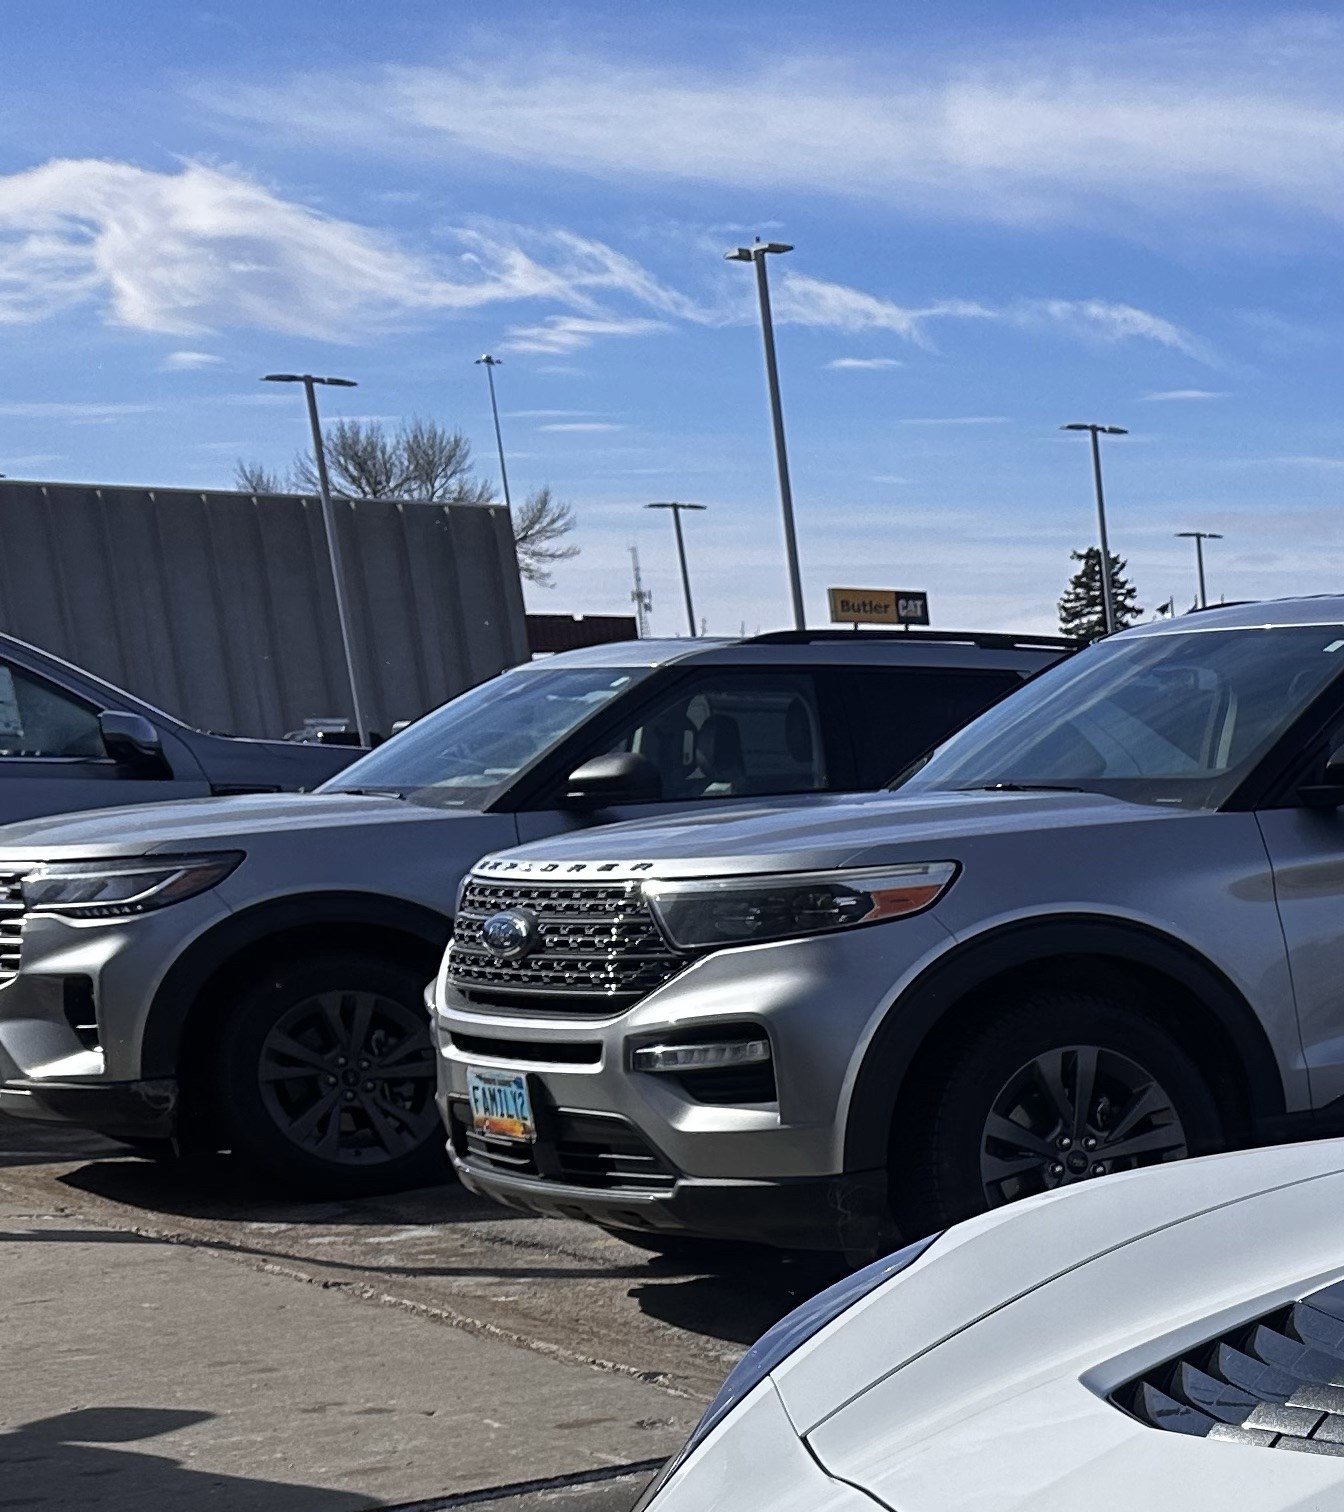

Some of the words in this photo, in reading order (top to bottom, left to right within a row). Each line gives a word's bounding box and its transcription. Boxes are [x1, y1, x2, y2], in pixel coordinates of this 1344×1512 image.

[841, 599, 890, 614] Butler
[898, 598, 924, 617] CAT
[477, 860, 654, 873] EXPLORER
[472, 1085, 528, 1121] FAMILY2
